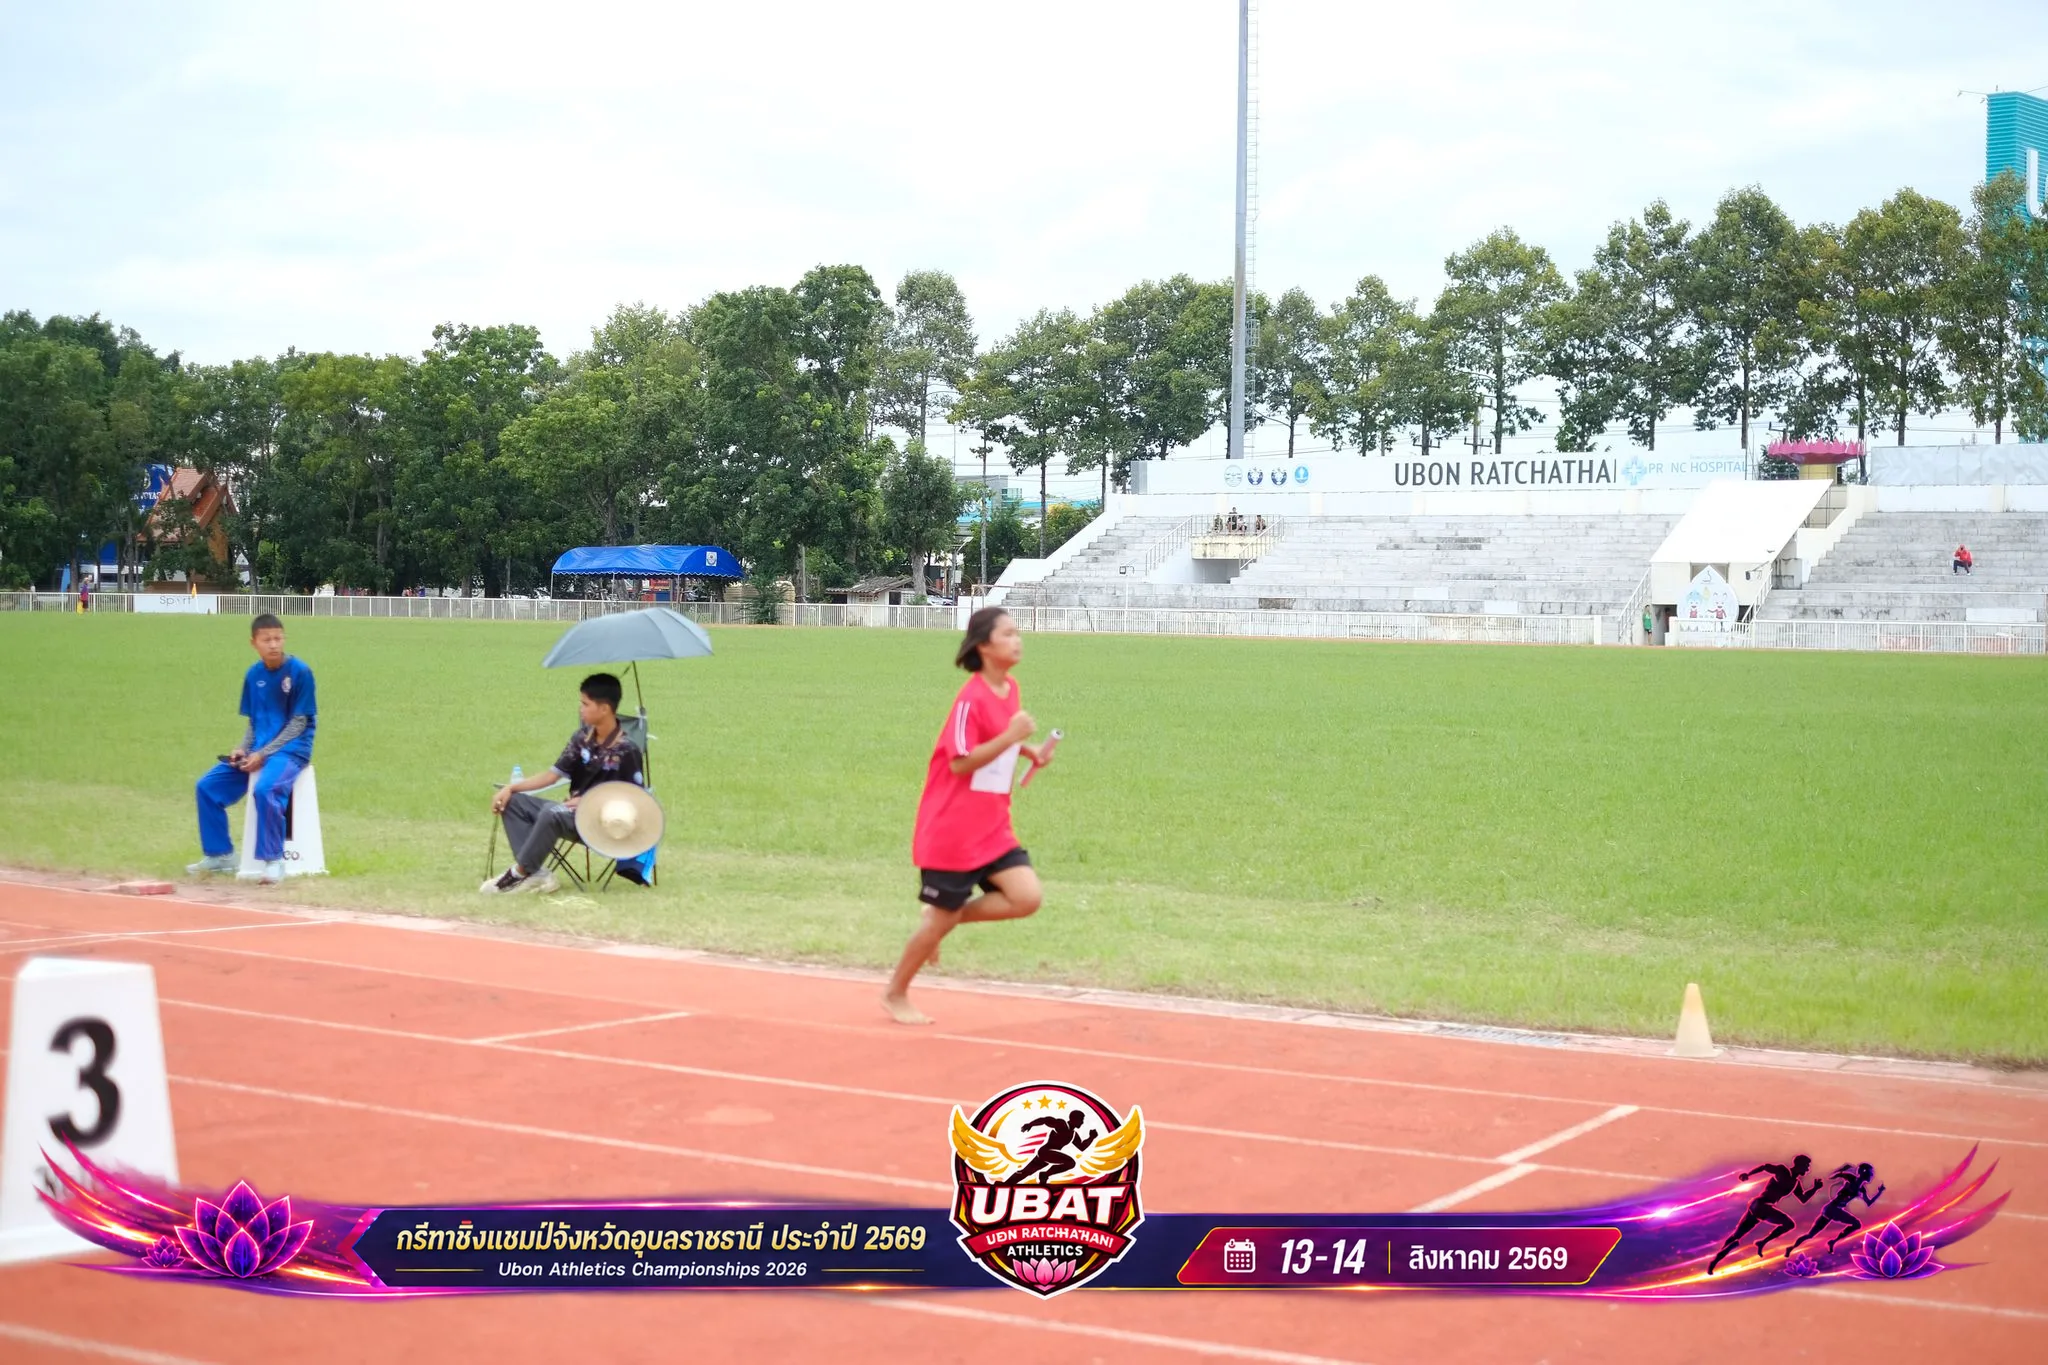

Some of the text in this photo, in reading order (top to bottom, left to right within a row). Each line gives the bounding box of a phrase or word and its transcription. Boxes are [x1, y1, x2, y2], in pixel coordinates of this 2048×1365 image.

[1394, 462, 1460, 486] UBON
[1648, 461, 1747, 474] PRNC HOSPITAL
[159, 595, 191, 606] Sprt
[48, 1015, 121, 1150] 3
